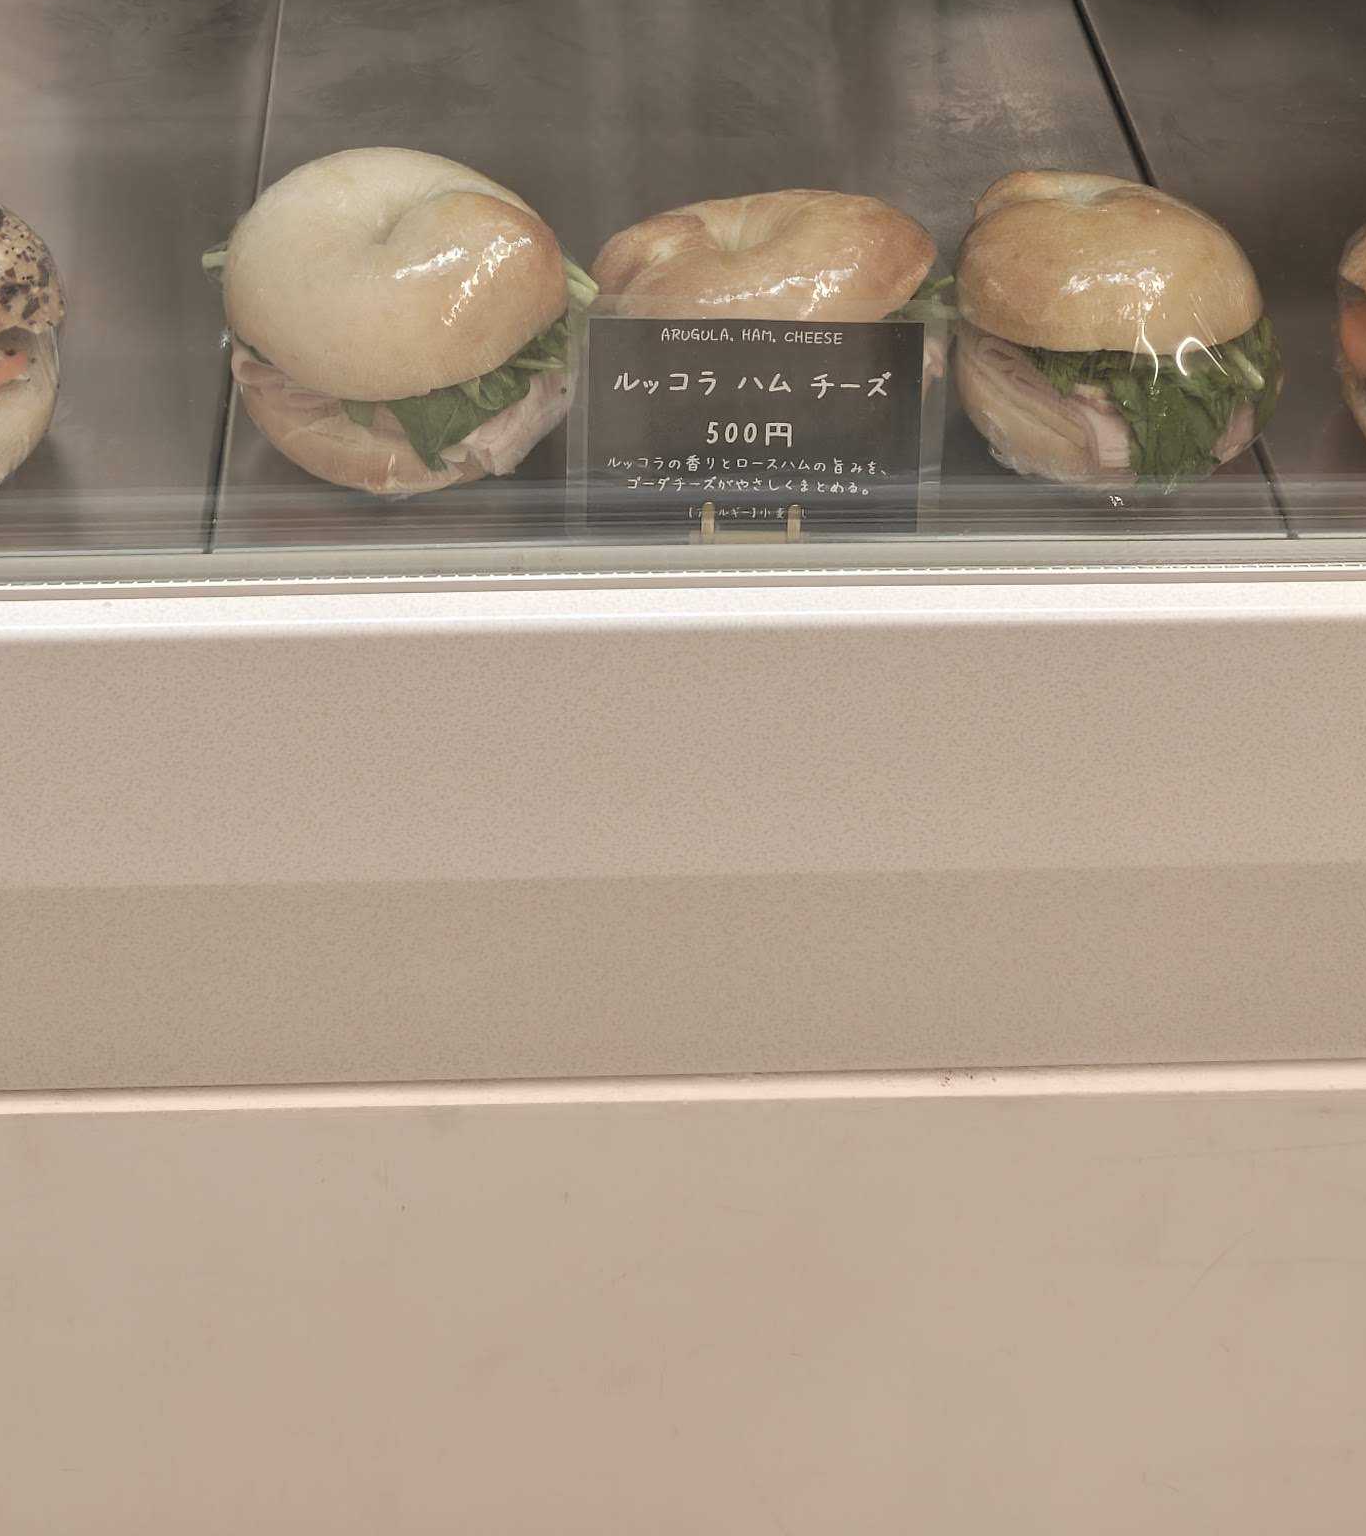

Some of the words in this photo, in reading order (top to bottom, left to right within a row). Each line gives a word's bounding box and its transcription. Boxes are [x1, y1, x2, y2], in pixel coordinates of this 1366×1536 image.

[784, 331, 843, 345] CHEESE
[613, 370, 718, 396] ルッコラ
[737, 373, 791, 393] ハム
[810, 371, 892, 400] チーズ
[706, 421, 792, 448] 500円
[607, 454, 891, 478] ルッコラの香りとロースハムの旨みを、
[627, 477, 870, 496] ゴーダチーズがやさしくまとめる。
